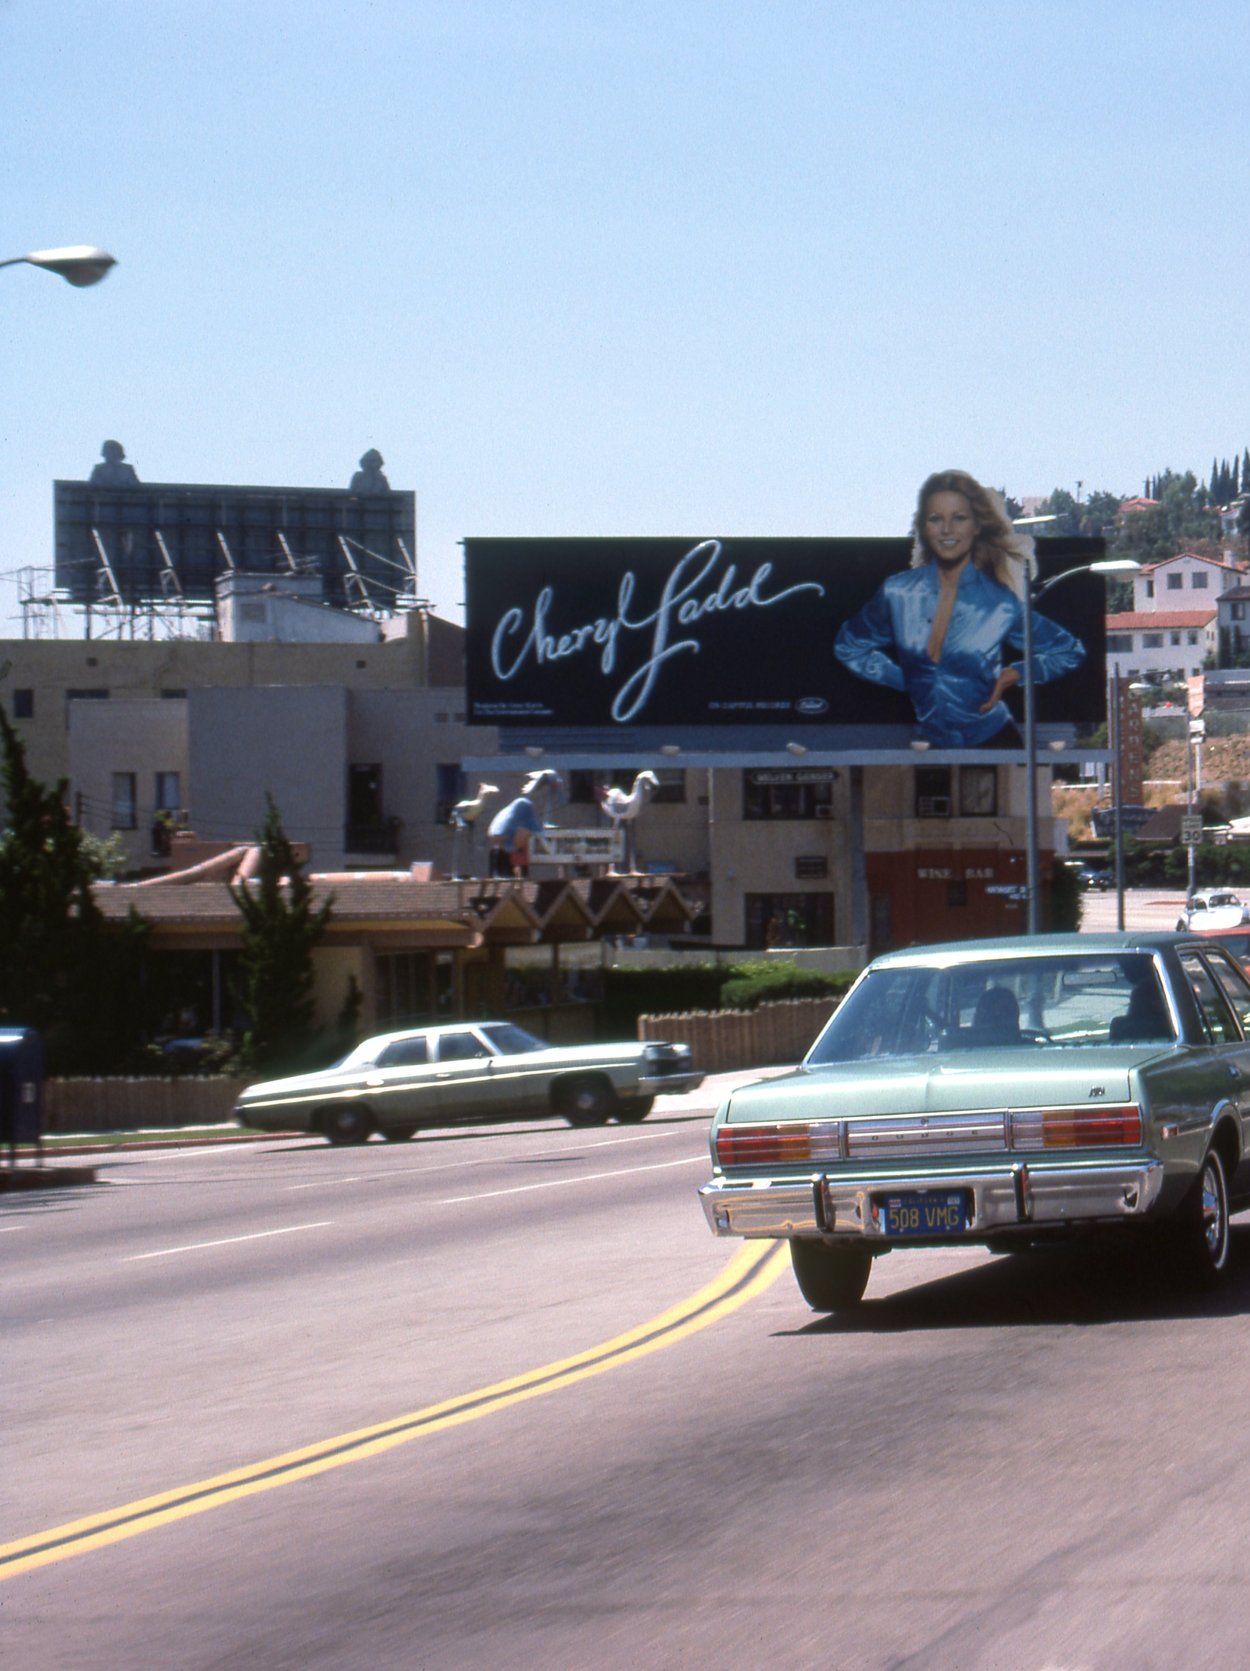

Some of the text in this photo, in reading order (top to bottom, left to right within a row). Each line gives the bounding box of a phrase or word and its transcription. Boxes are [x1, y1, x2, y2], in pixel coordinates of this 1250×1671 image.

[491, 538, 825, 722] Cheryl Ladd
[1183, 830, 1201, 841] 30
[888, 1205, 960, 1229] 508 VMG
